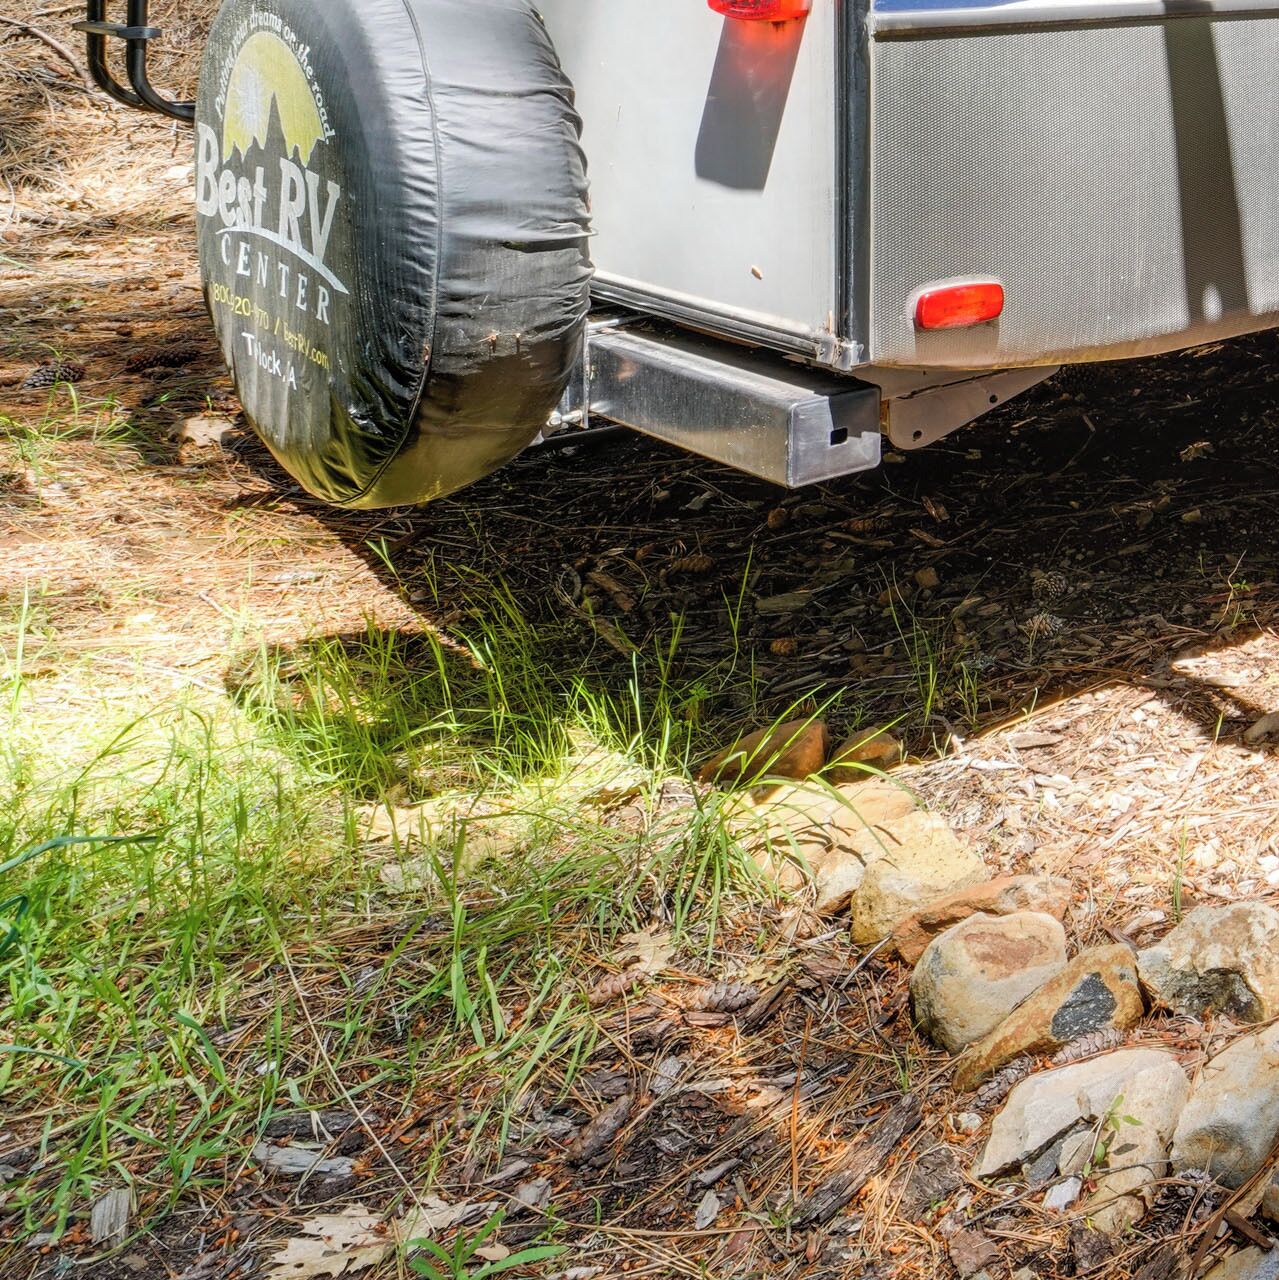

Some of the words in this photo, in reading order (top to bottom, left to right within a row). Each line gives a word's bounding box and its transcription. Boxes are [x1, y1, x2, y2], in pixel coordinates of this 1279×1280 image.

[250, 4, 282, 32] dreams
[297, 43, 314, 80] the
[196, 121, 267, 228] Best
[279, 157, 341, 264] RV
[221, 233, 330, 325] CENTER
